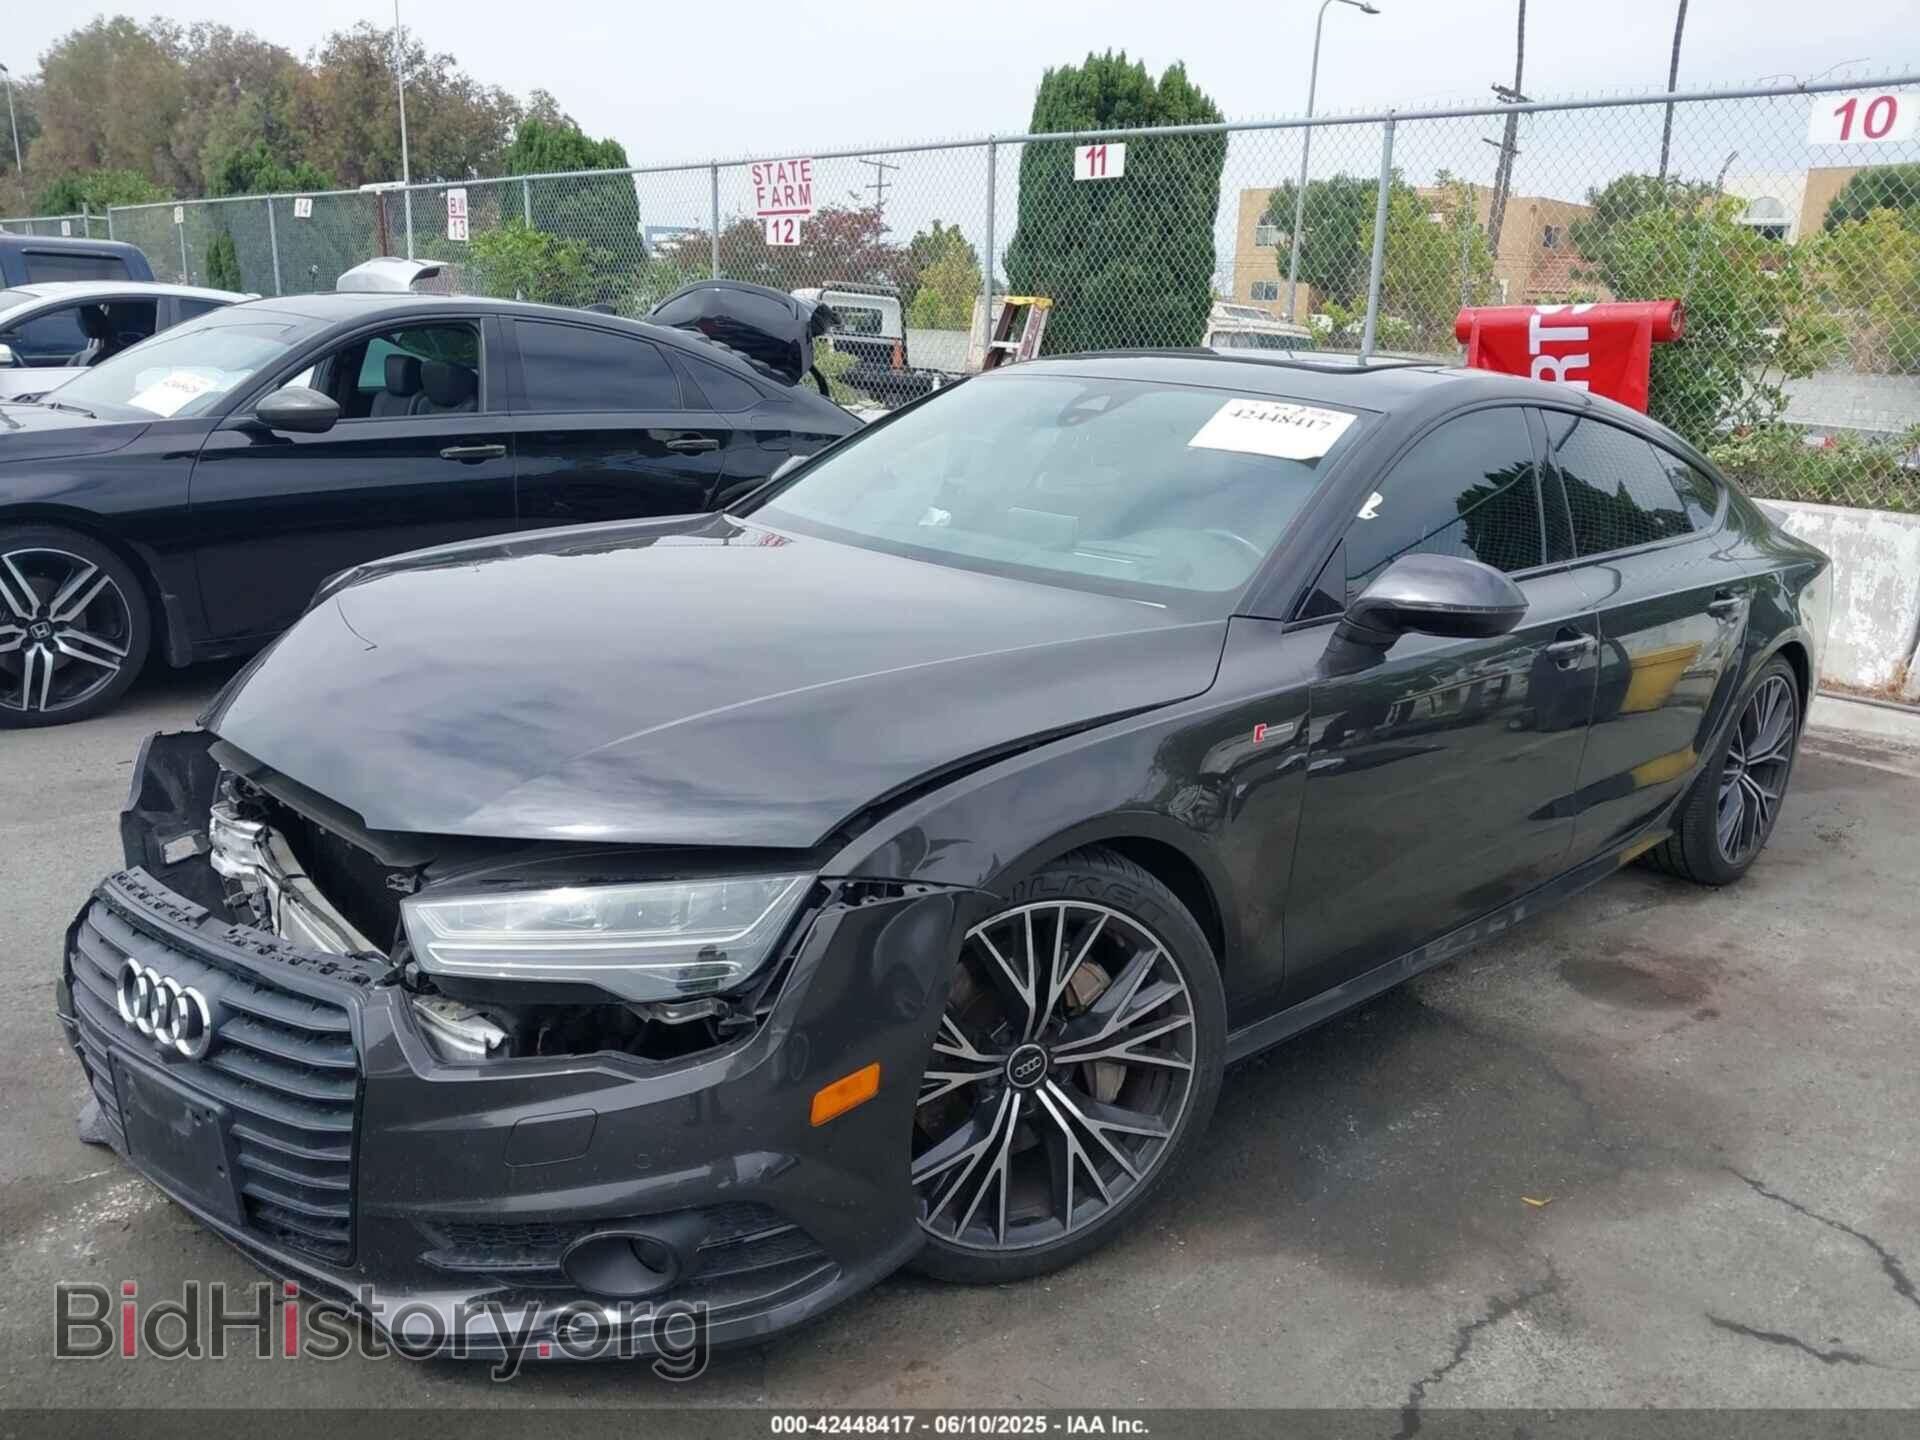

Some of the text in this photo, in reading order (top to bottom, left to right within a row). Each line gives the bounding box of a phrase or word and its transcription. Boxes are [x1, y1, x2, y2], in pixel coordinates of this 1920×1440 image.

[1834, 95, 1897, 141] 10
[752, 160, 812, 186] STATE
[1086, 145, 1107, 177] 11
[757, 184, 812, 208] FARM
[452, 220, 465, 238] 13
[772, 218, 794, 243] 12
[1230, 408, 1332, 431] 42448417
